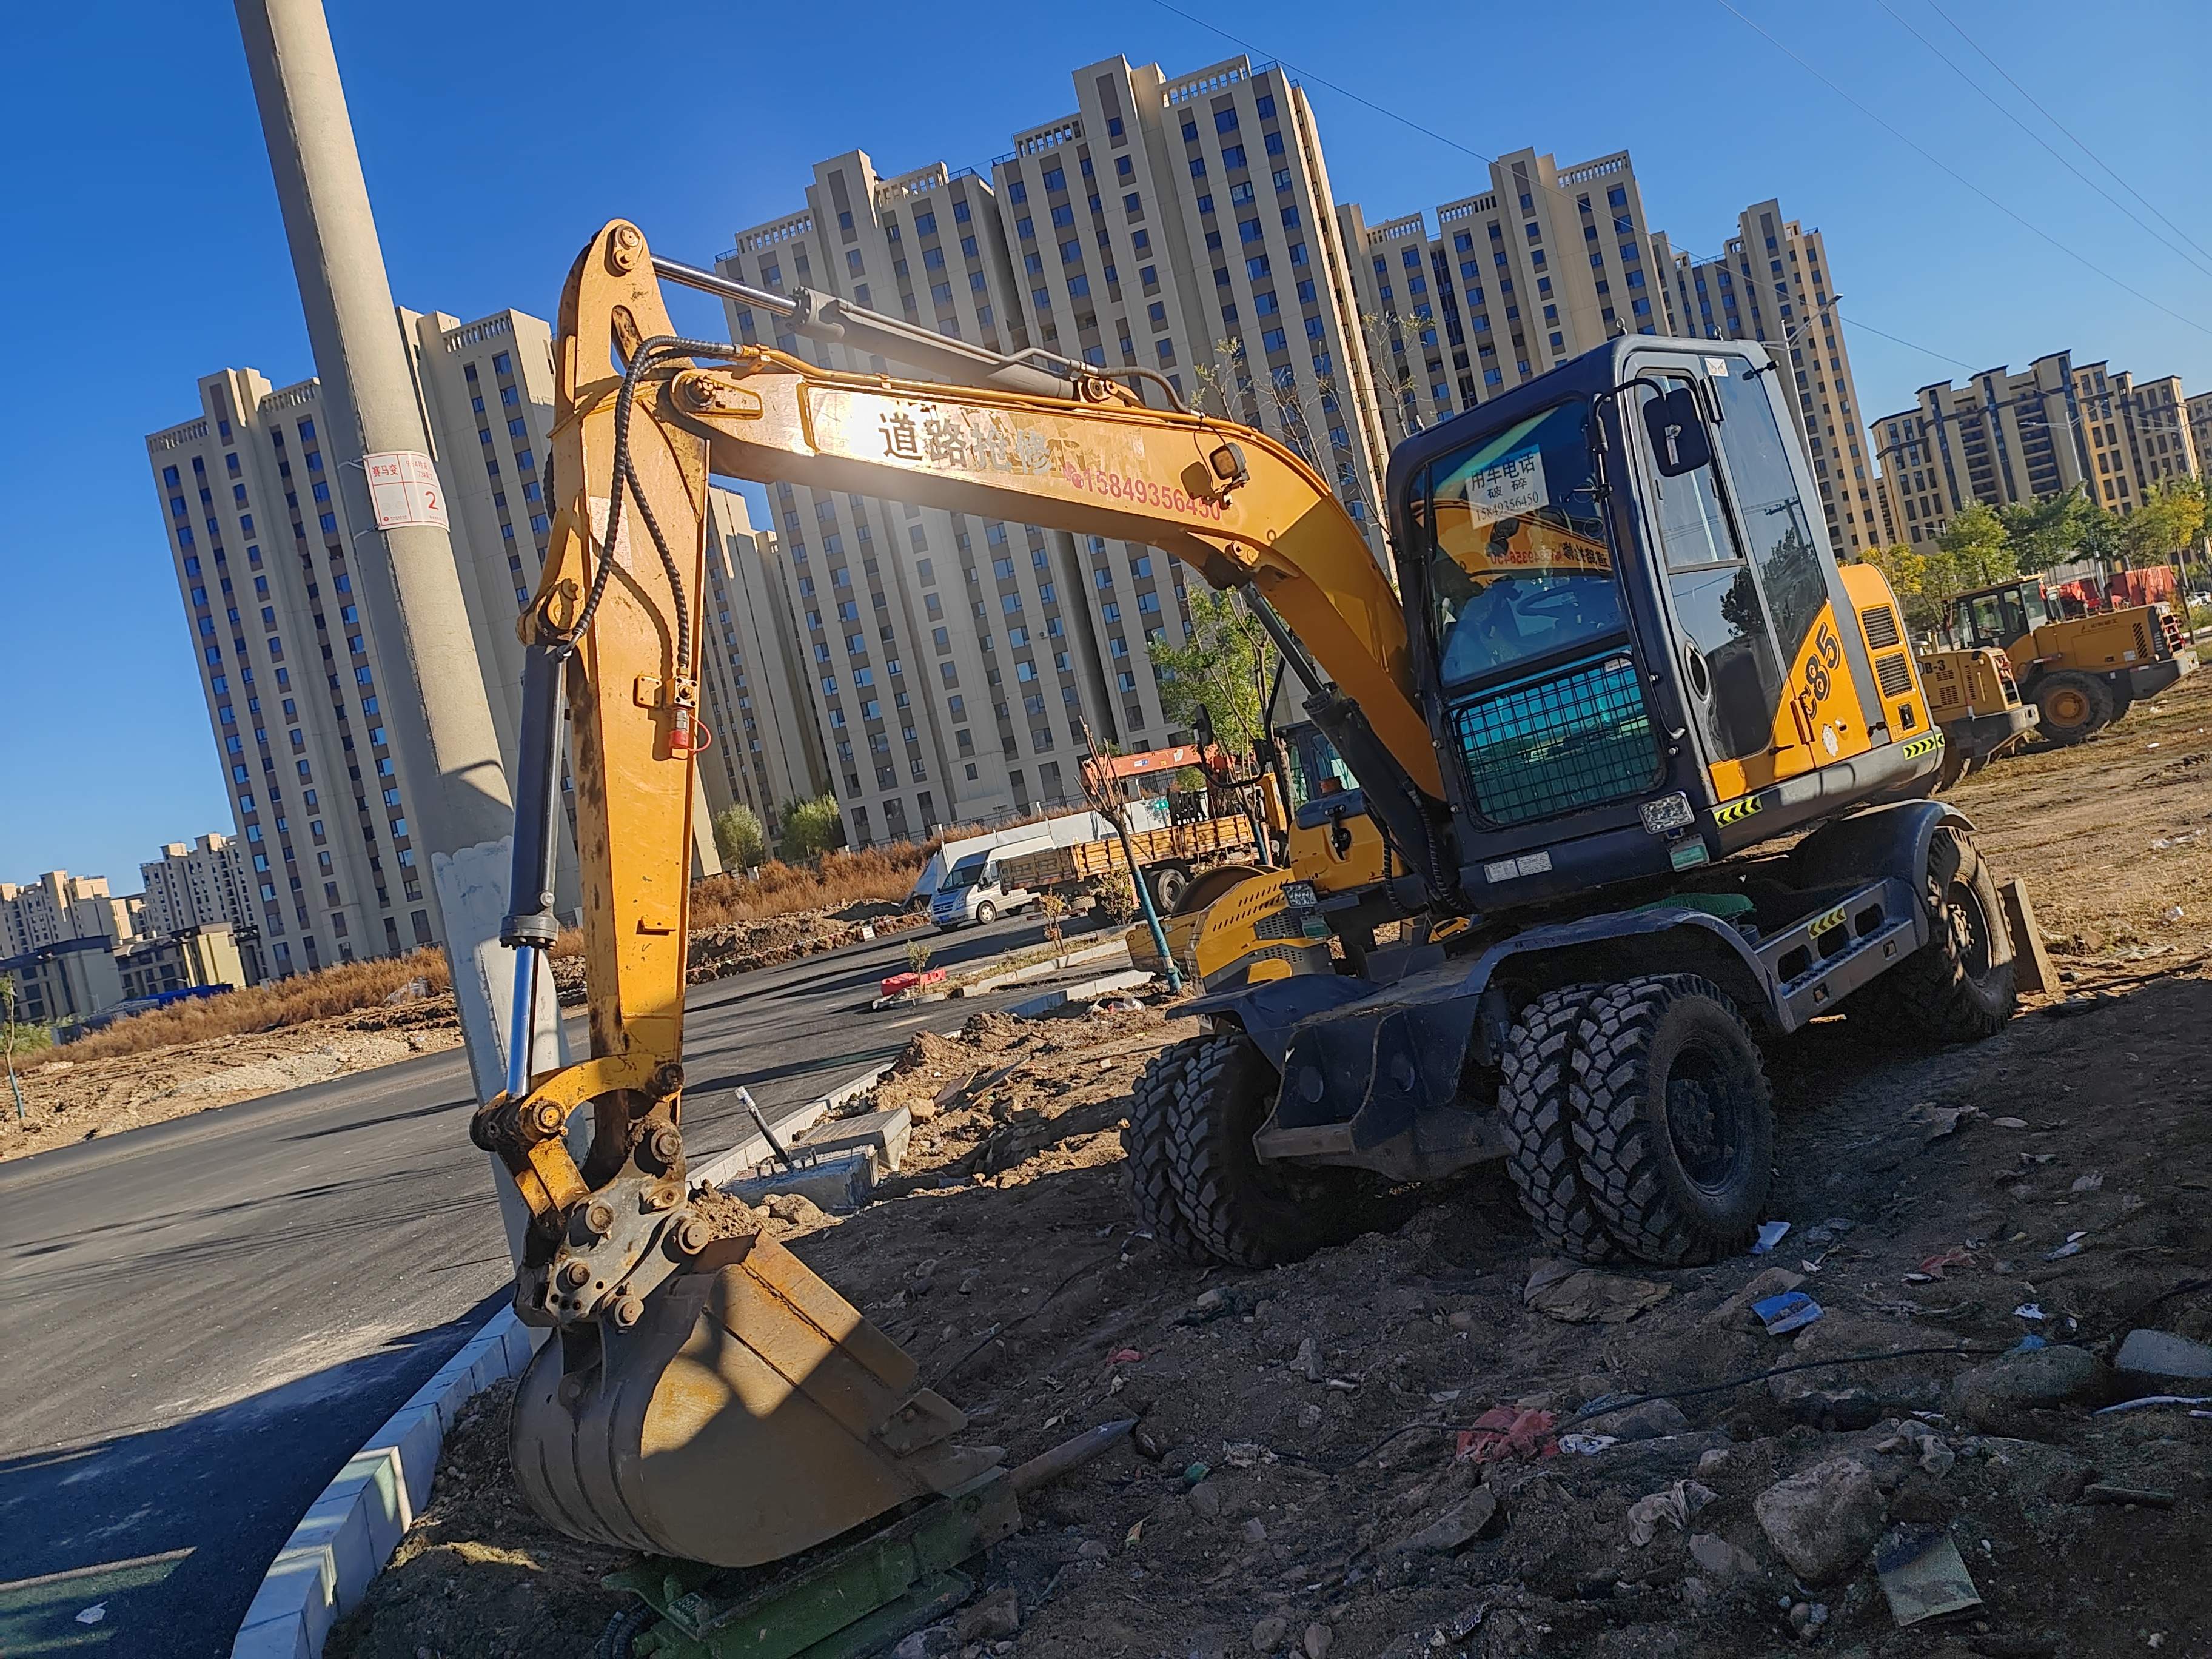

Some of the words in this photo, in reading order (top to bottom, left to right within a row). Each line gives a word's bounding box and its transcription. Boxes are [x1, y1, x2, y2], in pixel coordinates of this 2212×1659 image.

[879, 411, 1050, 475] 道路抢修
[372, 464, 398, 478] 赛马变
[1471, 451, 1535, 491] 用车电话
[425, 491, 439, 511] 2
[1083, 466, 1221, 521] 15849356450
[1476, 491, 1539, 521] 15849356450
